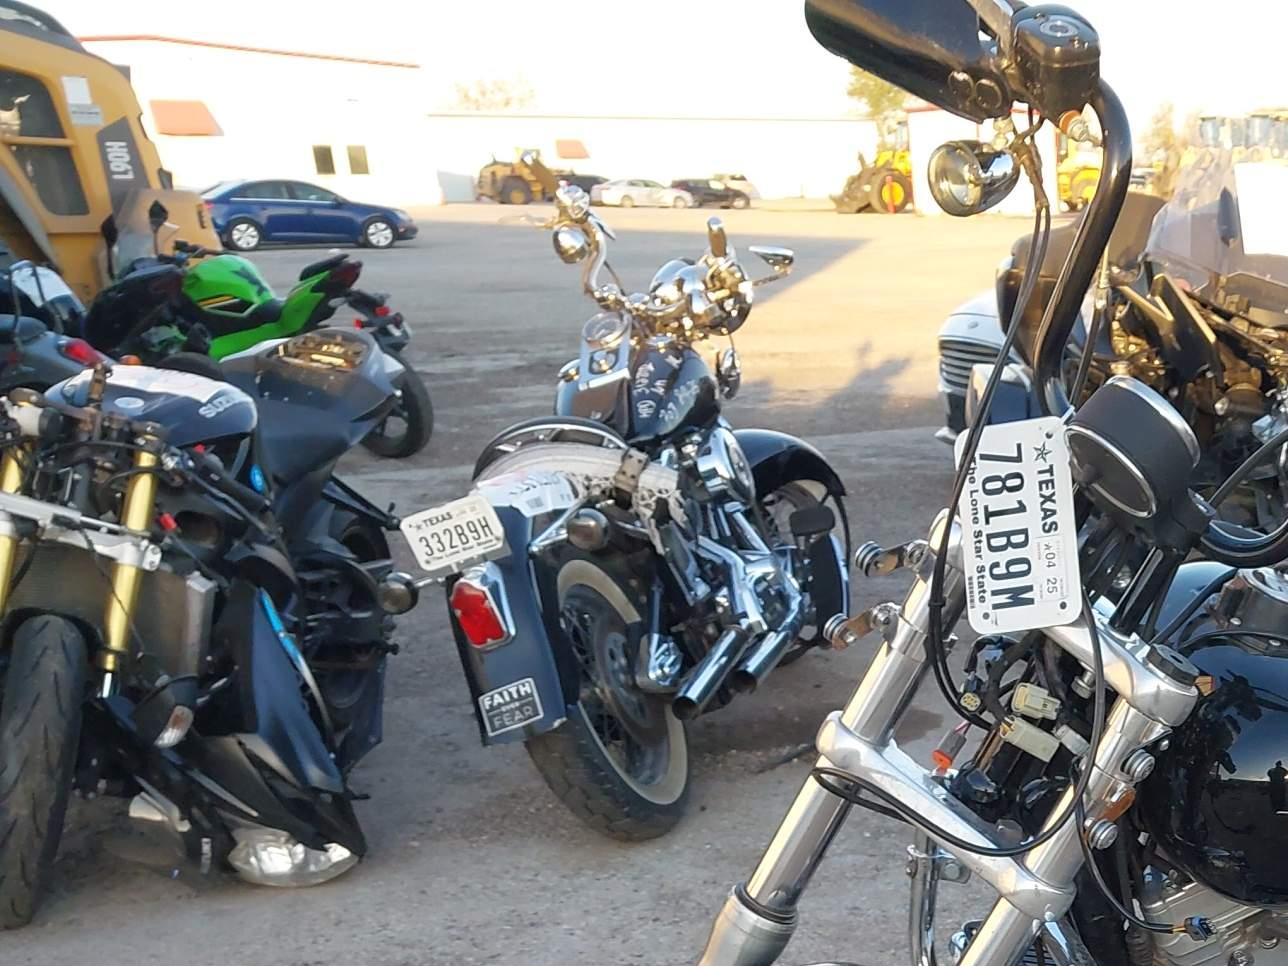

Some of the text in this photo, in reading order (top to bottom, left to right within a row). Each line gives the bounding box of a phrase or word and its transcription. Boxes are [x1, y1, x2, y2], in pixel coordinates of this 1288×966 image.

[104, 141, 135, 180] L90H
[970, 489, 980, 525] Lone
[1037, 464, 1058, 533] TEXAS
[418, 515, 494, 557] 332B9H
[422, 511, 453, 528] TEXAS
[979, 442, 1035, 611] 781B9M
[973, 530, 983, 560] Star
[976, 564, 987, 604] State
[1044, 551, 1058, 594] 04 25
[483, 682, 532, 710] FAITH
[493, 705, 534, 729] FEAR
